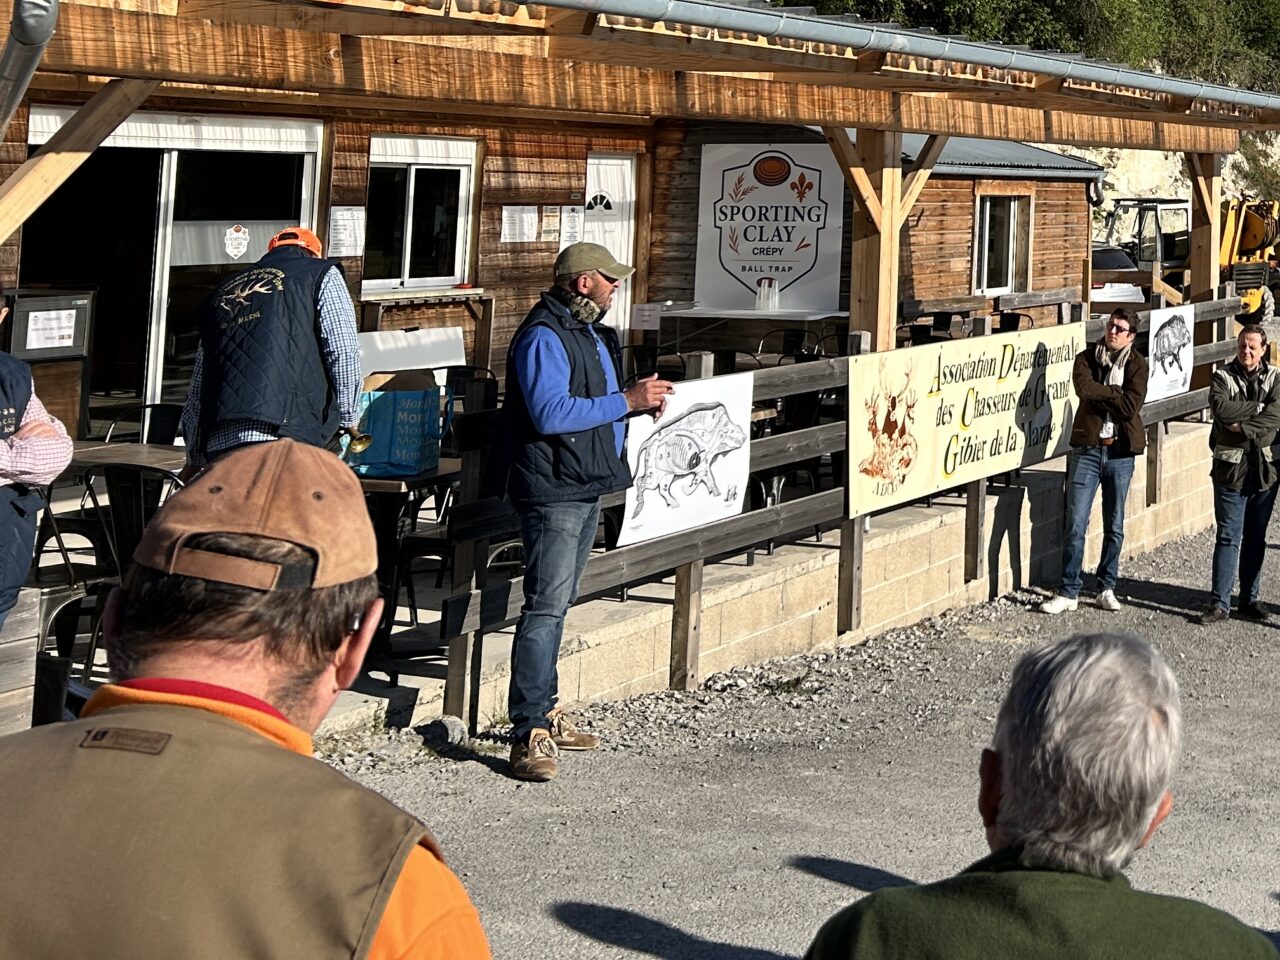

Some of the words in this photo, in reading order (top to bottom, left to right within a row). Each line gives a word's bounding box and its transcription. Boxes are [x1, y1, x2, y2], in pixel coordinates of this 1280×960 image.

[718, 204, 822, 223] SPORTING
[743, 225, 797, 243] CLAY
[752, 245, 784, 257] CRÉPY
[741, 265, 765, 273] BALL
[768, 265, 794, 273] TRAP
[929, 348, 997, 394] Association
[998, 337, 1079, 381] Départementale
[936, 397, 954, 428] des
[960, 387, 1018, 429] Chasseurs
[1019, 385, 1032, 408] de
[1034, 372, 1072, 410] Grand
[944, 434, 987, 476] Gibier
[989, 435, 1003, 457] de
[1005, 427, 1017, 453] la
[1019, 420, 1056, 450] Marne
